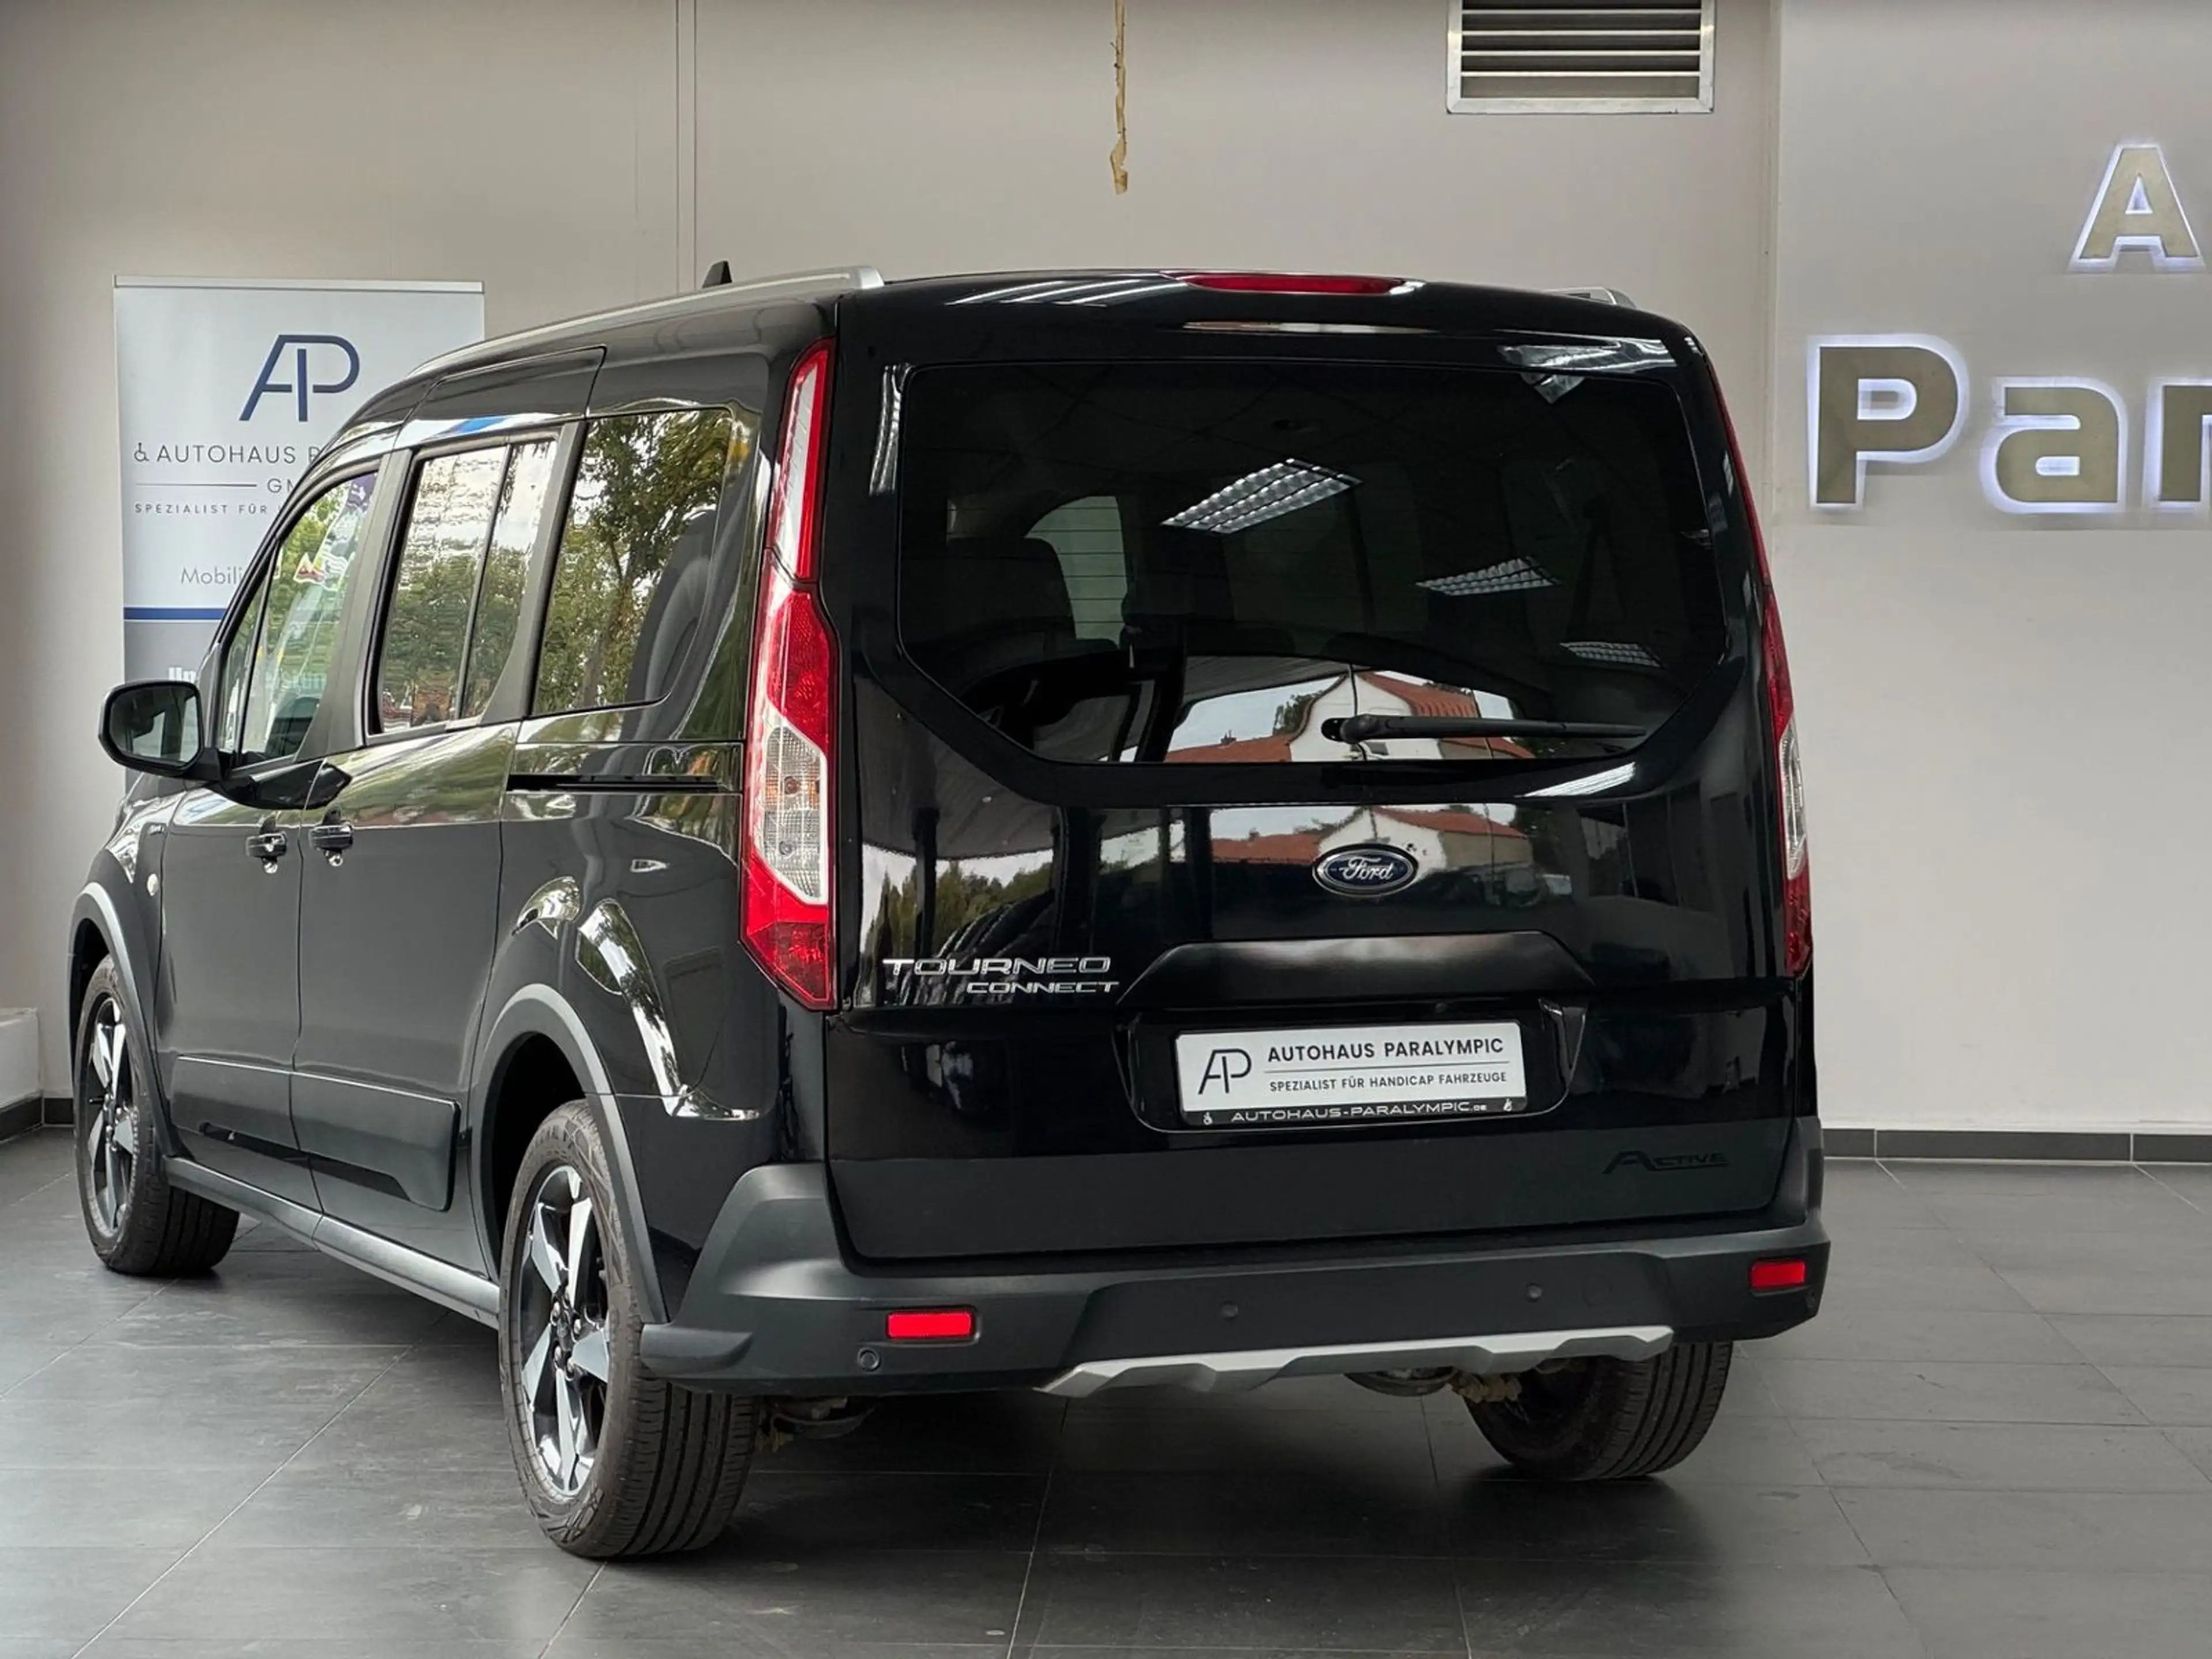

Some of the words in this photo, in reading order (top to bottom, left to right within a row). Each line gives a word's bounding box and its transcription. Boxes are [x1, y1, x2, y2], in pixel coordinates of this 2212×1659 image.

[156, 445, 296, 464] AUTOHAUS
[135, 503, 228, 514] SPEZIALIST
[238, 503, 267, 514] FÜR
[1339, 857, 1395, 880] Ford
[882, 956, 1112, 976] TOURNEO
[966, 981, 1120, 994] CONNECT
[1198, 1048, 1252, 1095] AP
[1268, 1043, 1376, 1062] AUTOHAUS
[1384, 1038, 1504, 1058] PARALYMPIC
[1270, 1078, 1337, 1092] SPEZIALIST
[1342, 1075, 1365, 1089] FÜR
[1370, 1074, 1435, 1088] HANDICAP
[1439, 1071, 1507, 1085] FAHRZEUGE
